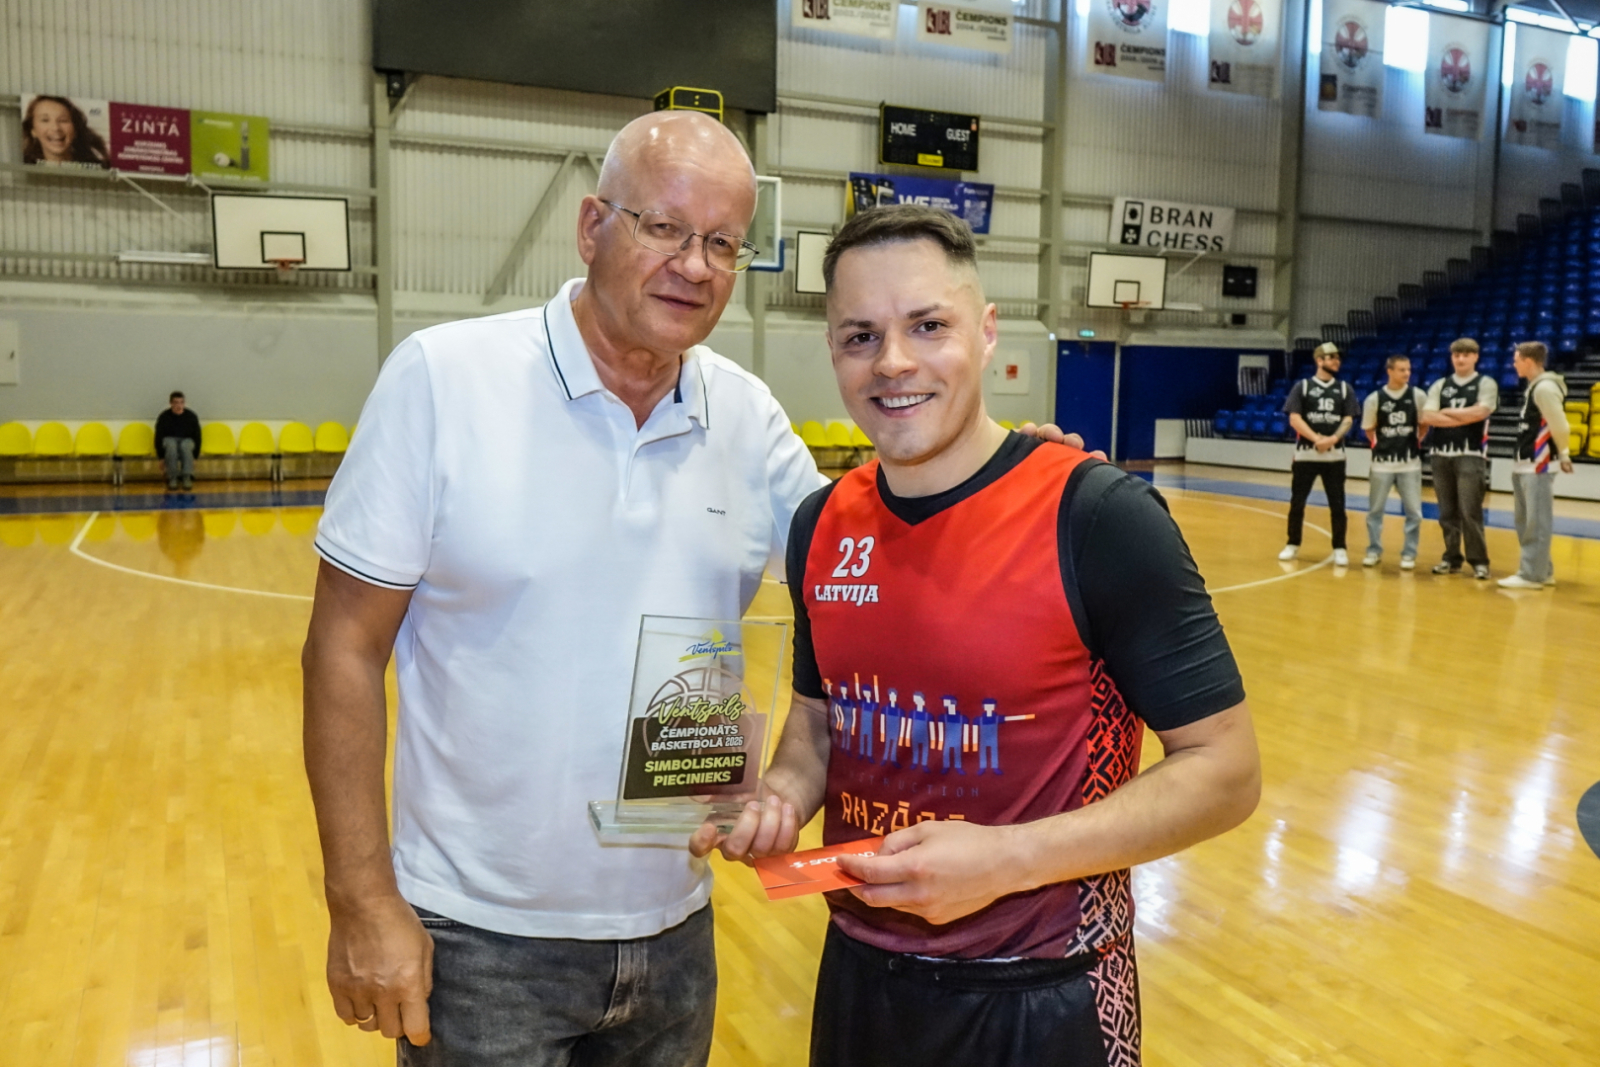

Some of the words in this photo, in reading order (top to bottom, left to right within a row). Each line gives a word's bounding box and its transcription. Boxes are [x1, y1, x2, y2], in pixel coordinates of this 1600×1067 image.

[955, 9, 1008, 26] ČEMPIONS
[121, 117, 180, 137] ZINTA
[890, 121, 917, 137] HOME
[945, 127, 971, 142] GUEST
[1149, 206, 1214, 229] BRAN
[1146, 229, 1224, 252] CHESS
[1317, 396, 1335, 412] 16
[1388, 410, 1407, 426] 69
[706, 507, 727, 517] GANT
[831, 535, 876, 578] 23
[814, 584, 879, 607] LATVIJA
[686, 641, 733, 660] Ventspils
[657, 692, 746, 725] Ventspils
[659, 723, 739, 739] ČEMPIONĀTS
[651, 737, 724, 751] BASKETBOLĀ
[724, 736, 744, 747] 2026
[644, 755, 745, 773] SIMBOLISKAIS
[653, 770, 732, 787] PIECINIEKS
